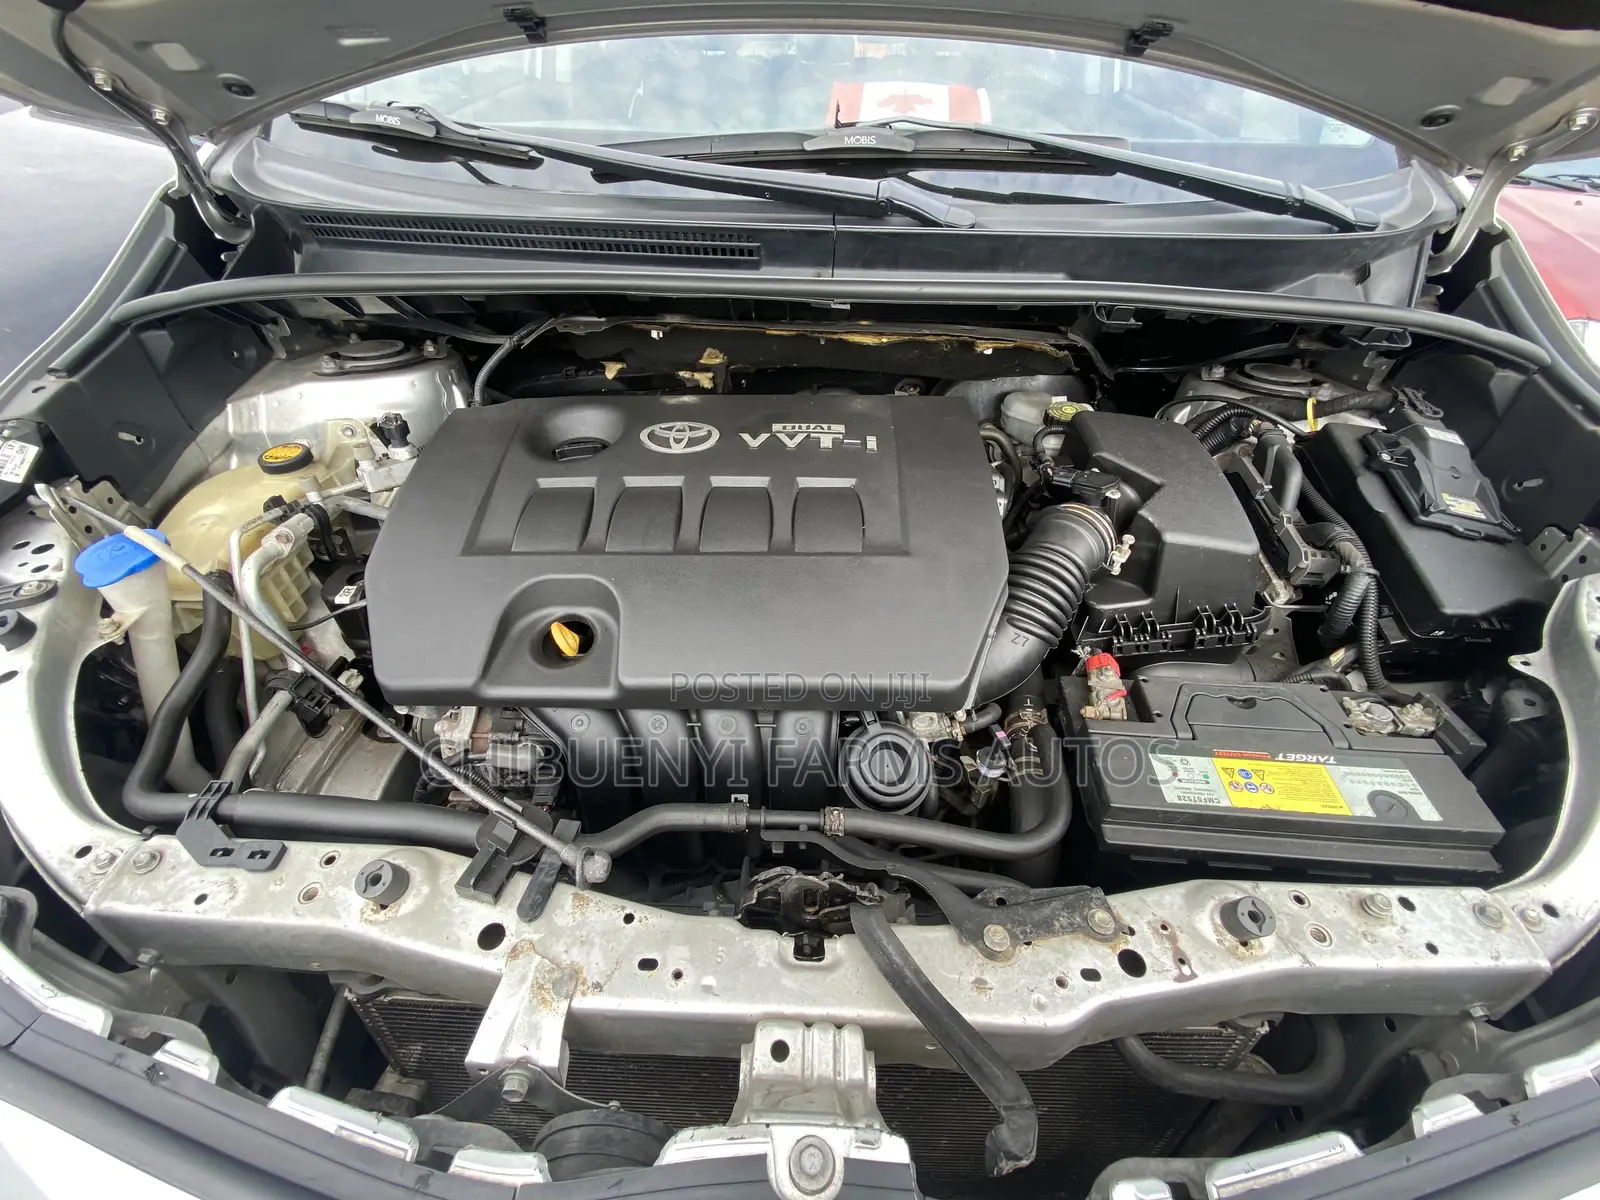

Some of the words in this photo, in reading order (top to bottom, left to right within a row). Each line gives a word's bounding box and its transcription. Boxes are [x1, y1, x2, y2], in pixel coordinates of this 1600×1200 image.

[375, 113, 401, 125] MOBIS
[844, 135, 877, 145] MOBIS
[779, 423, 843, 432] DUAL
[1274, 753, 1337, 764] TARGET
